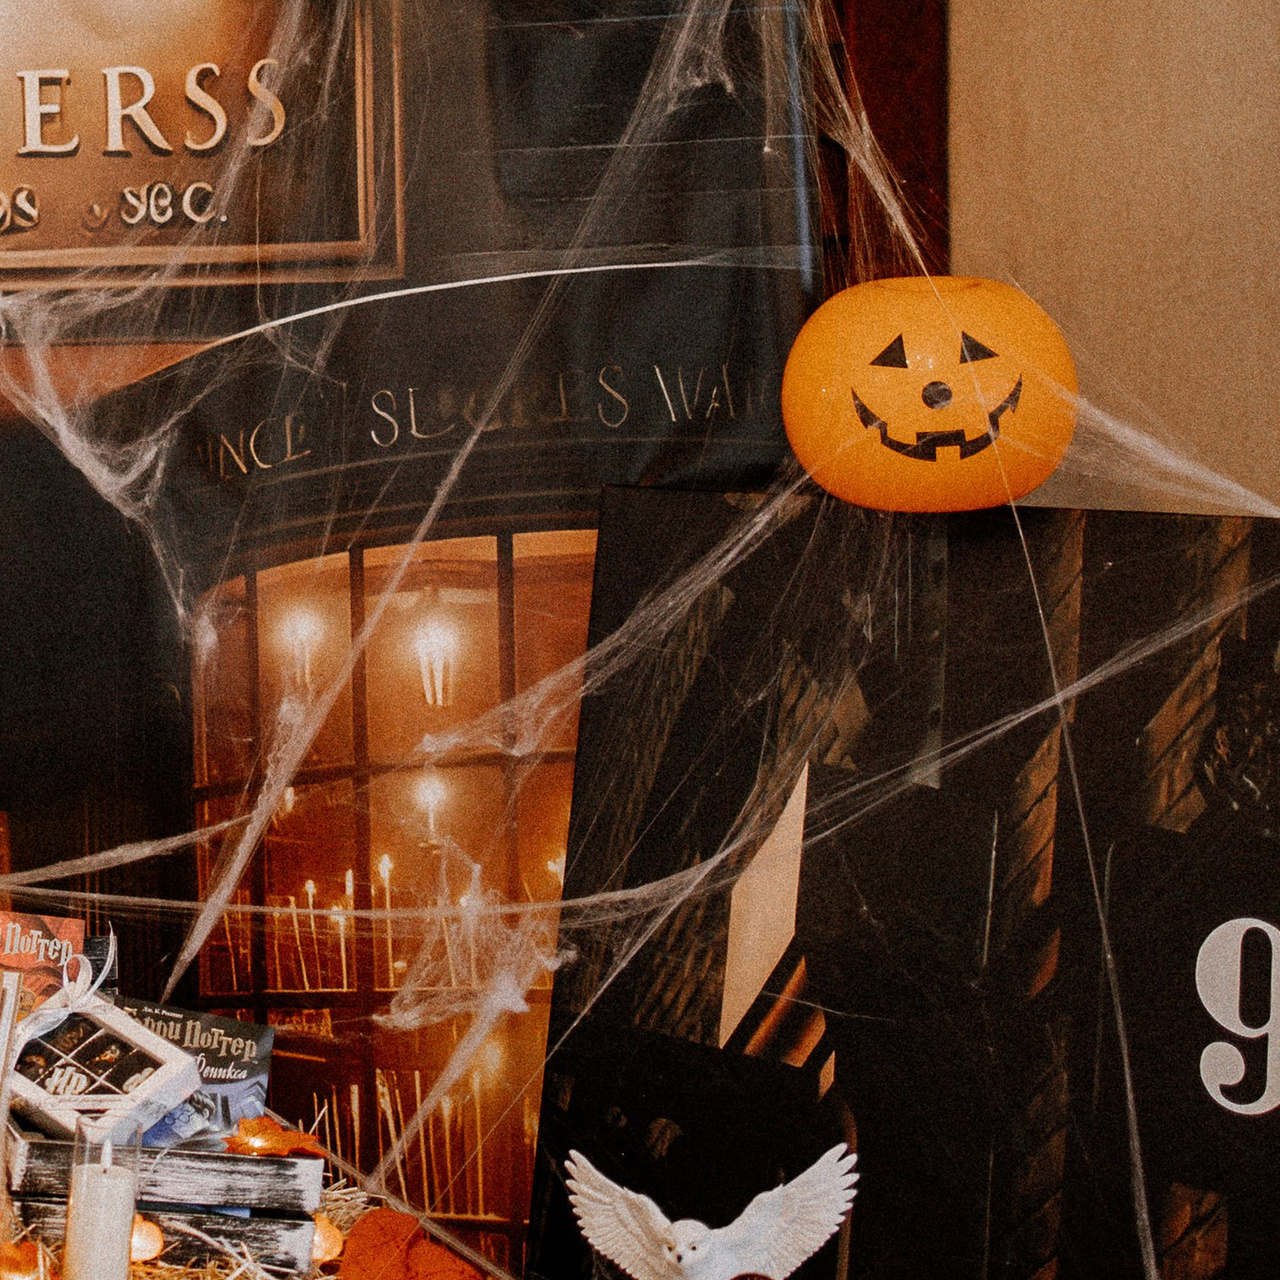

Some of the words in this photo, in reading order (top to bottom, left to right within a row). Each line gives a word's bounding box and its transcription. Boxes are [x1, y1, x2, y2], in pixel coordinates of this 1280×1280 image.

[3, 921, 73, 967] Поттер
[1195, 917, 1280, 1115] 9
[183, 1019, 259, 1064] Поттер
